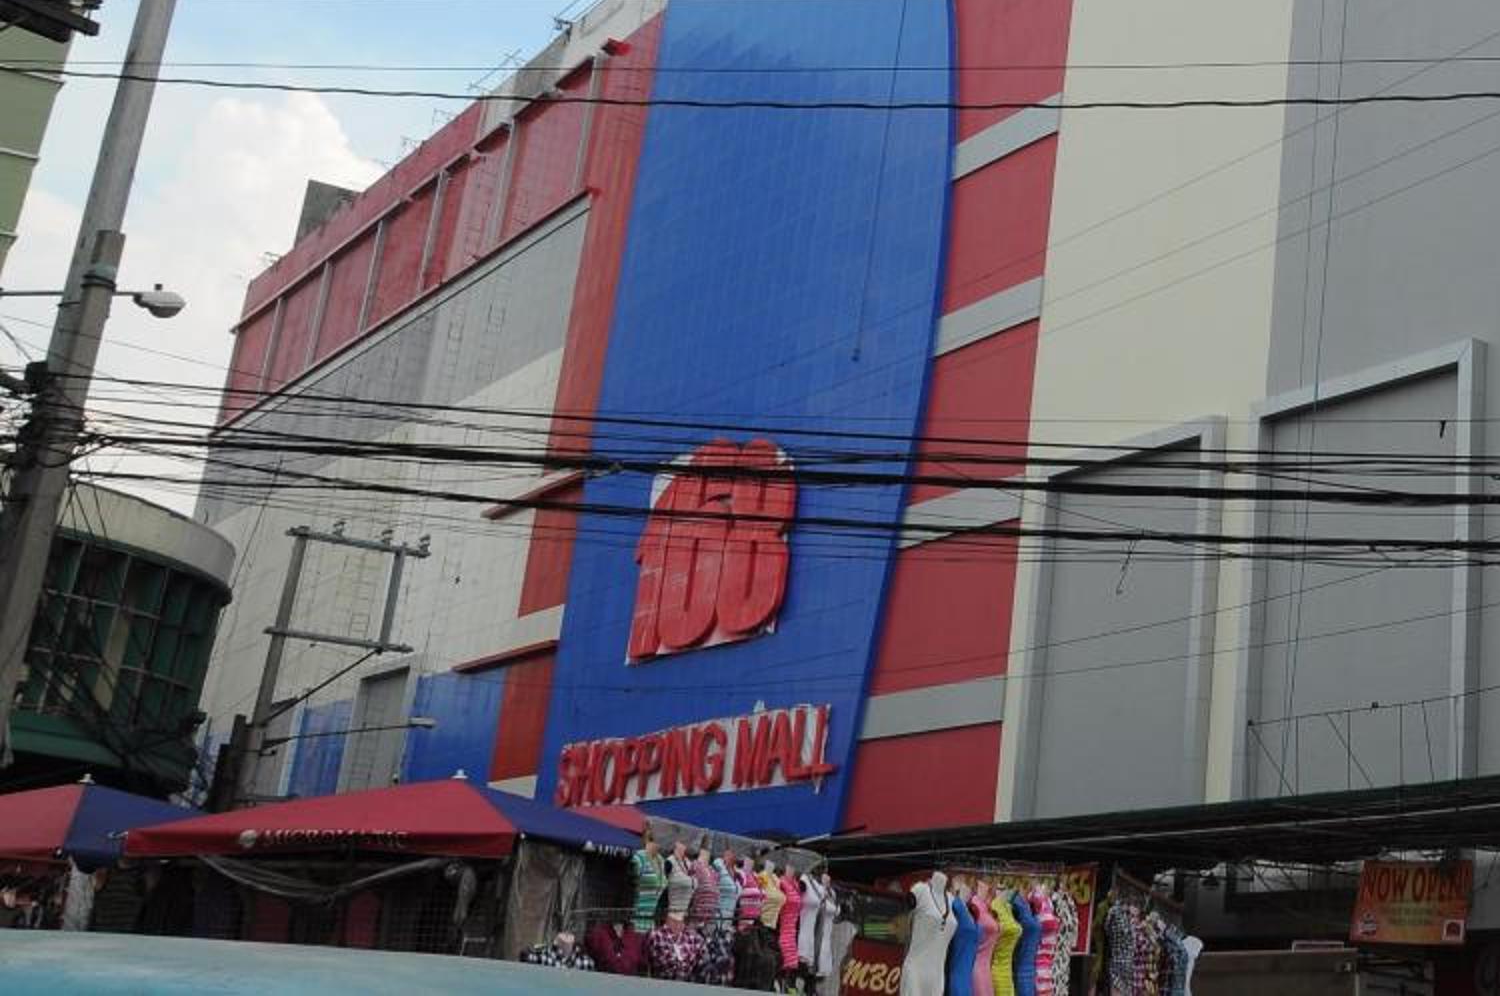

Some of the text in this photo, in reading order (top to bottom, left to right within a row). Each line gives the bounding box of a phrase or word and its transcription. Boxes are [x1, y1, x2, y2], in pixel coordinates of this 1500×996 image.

[628, 439, 799, 662] 168
[555, 706, 837, 808] SHOPPING MALL
[1360, 866, 1408, 901] NOW
